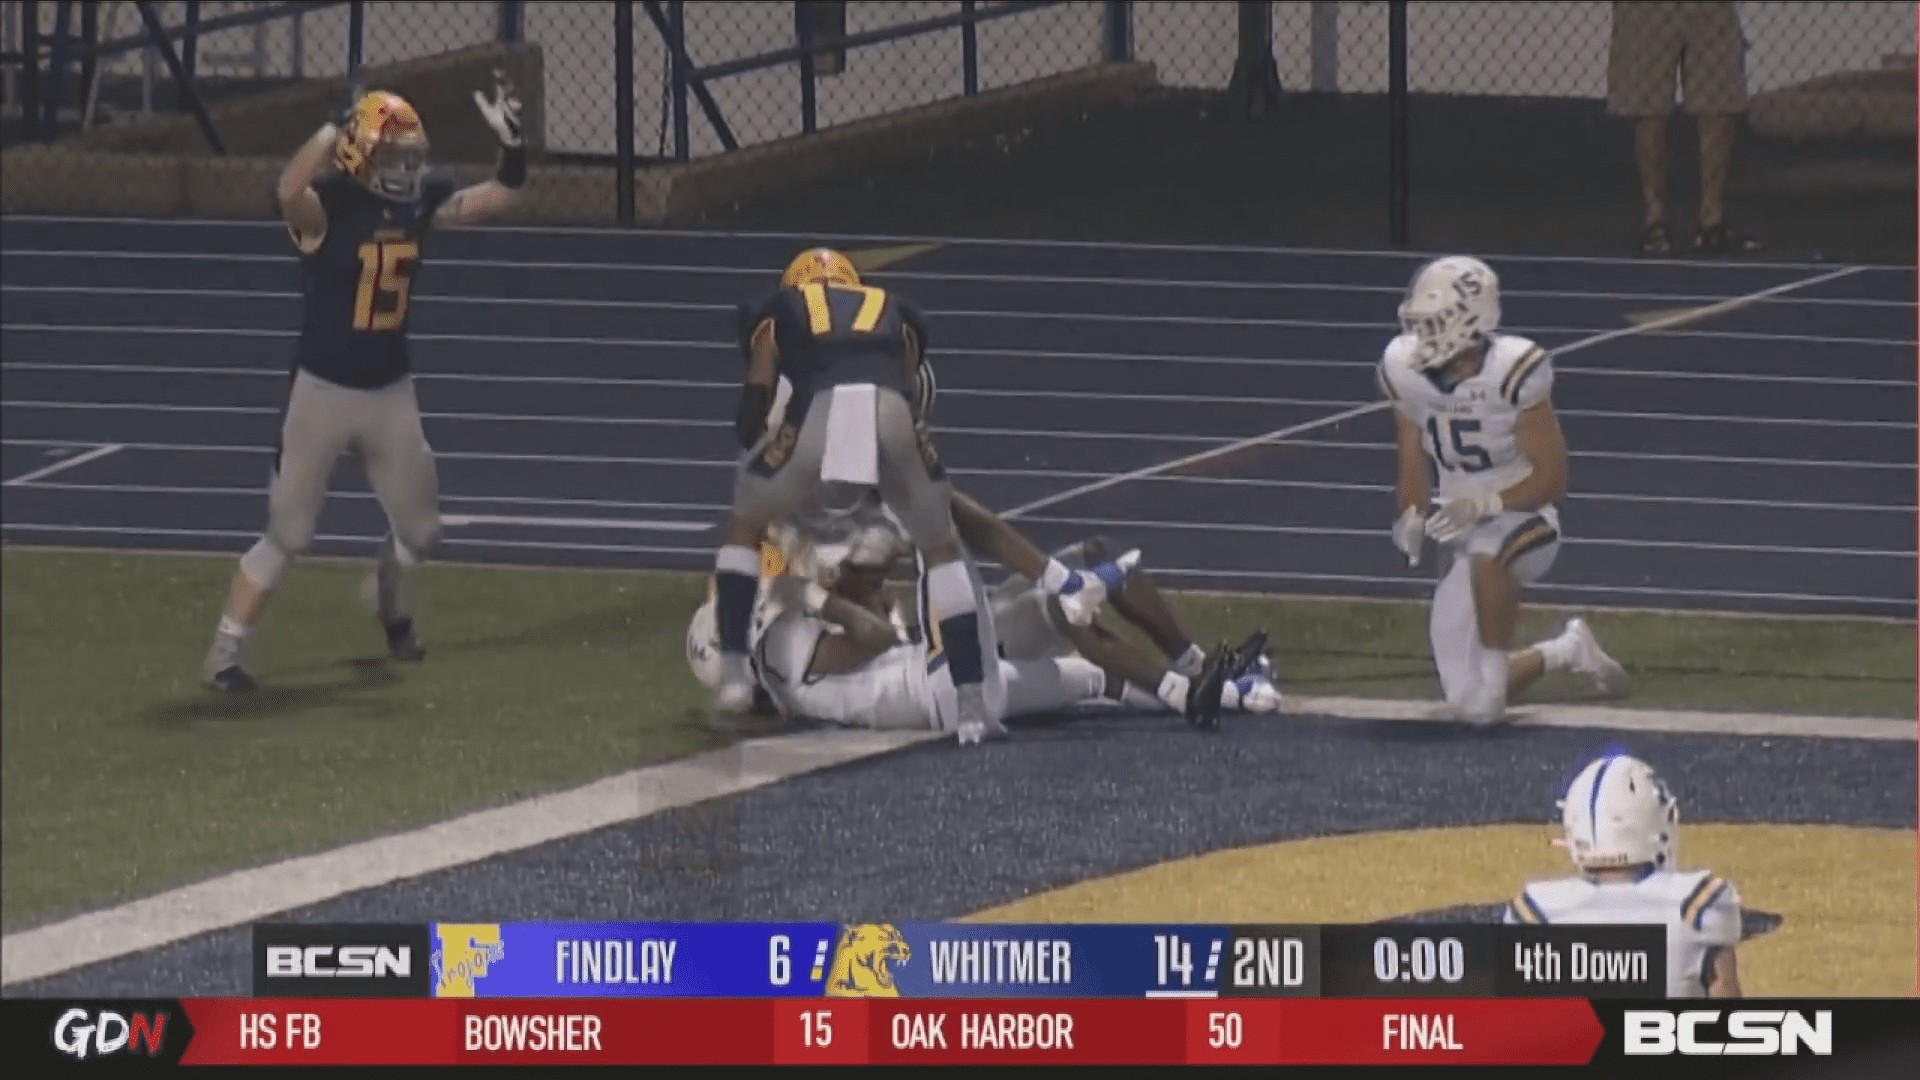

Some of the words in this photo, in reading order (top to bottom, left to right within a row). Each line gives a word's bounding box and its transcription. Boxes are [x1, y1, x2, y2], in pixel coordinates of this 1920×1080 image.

[353, 242, 419, 330] 15
[798, 282, 886, 335] 17
[1427, 415, 1492, 471] 15
